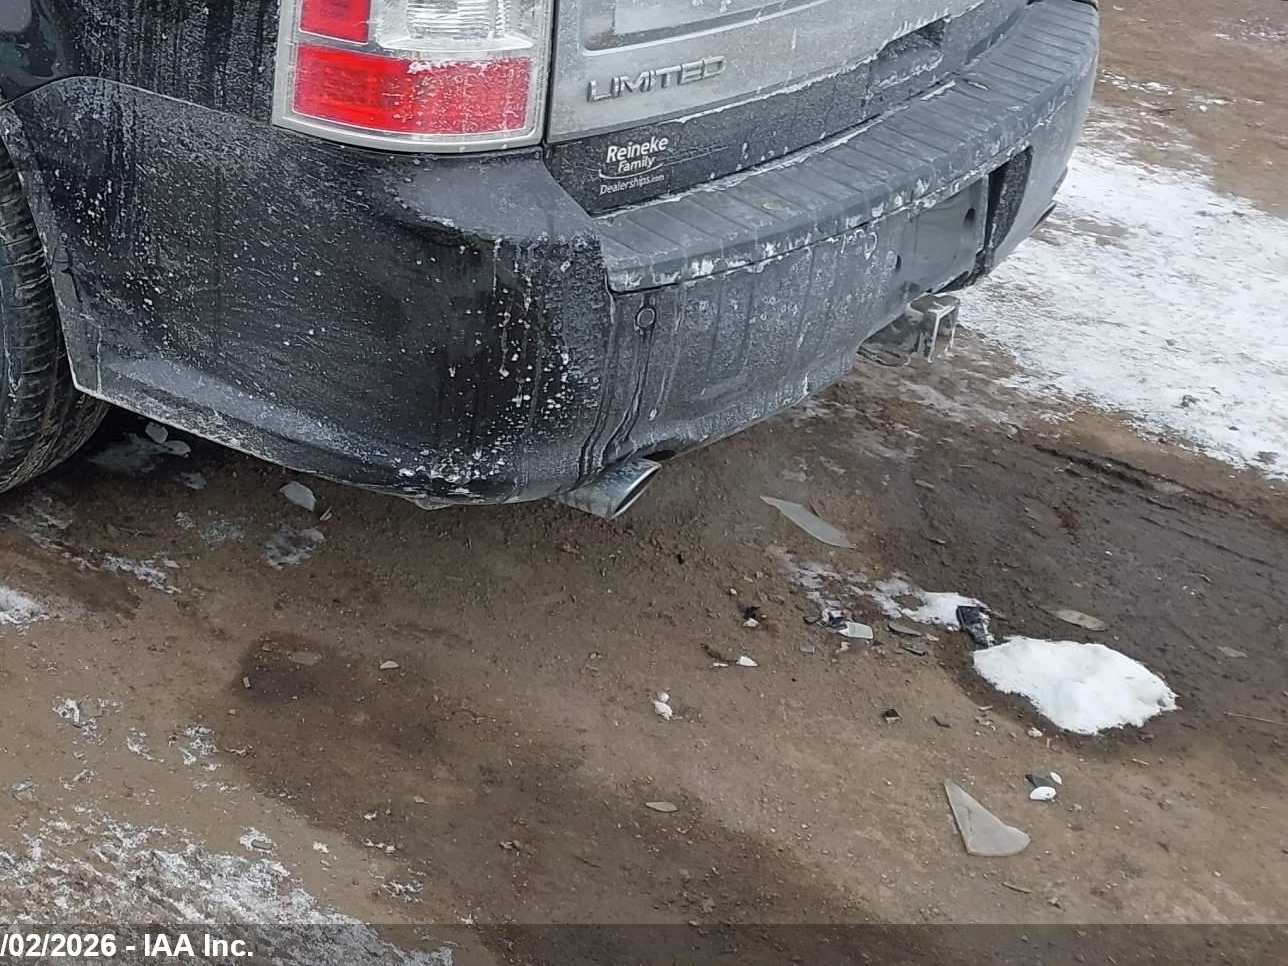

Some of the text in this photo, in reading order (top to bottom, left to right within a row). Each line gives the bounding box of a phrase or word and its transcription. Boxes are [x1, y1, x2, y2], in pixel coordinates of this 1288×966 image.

[586, 55, 726, 102] LIMITED
[606, 135, 669, 164] Reineke
[618, 155, 656, 173] Family
[599, 174, 665, 195] Dealerships.com
